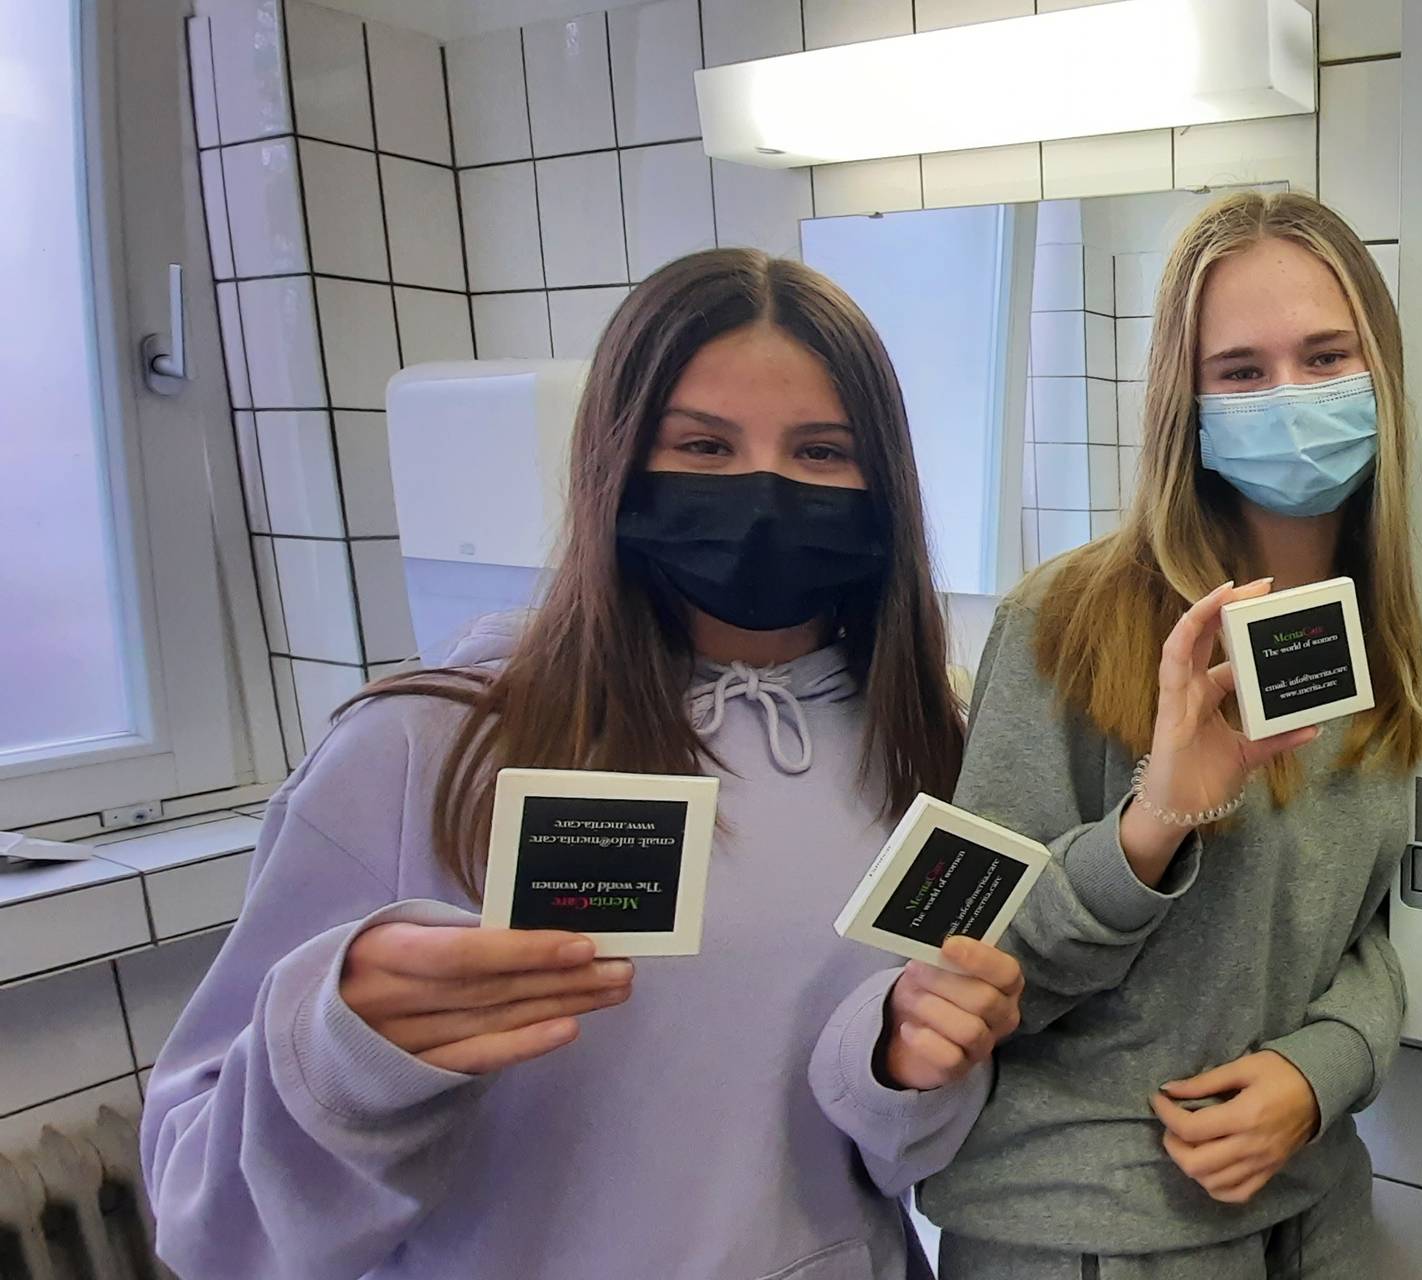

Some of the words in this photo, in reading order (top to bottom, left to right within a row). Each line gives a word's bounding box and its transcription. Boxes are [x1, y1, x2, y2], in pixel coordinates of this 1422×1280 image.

[1262, 648, 1279, 658] The
[1280, 641, 1302, 655] world
[1302, 639, 1311, 648] of
[1312, 633, 1338, 646] women
[554, 819, 656, 831] www.merita.care
[529, 834, 636, 848] info@merita.care
[638, 835, 676, 846] email:
[531, 881, 578, 891] women
[579, 881, 595, 893] of
[597, 880, 633, 892] world
[636, 882, 662, 893] The
[910, 912, 926, 928] The
[923, 888, 941, 912] world
[938, 877, 948, 889] of
[944, 849, 966, 879] women
